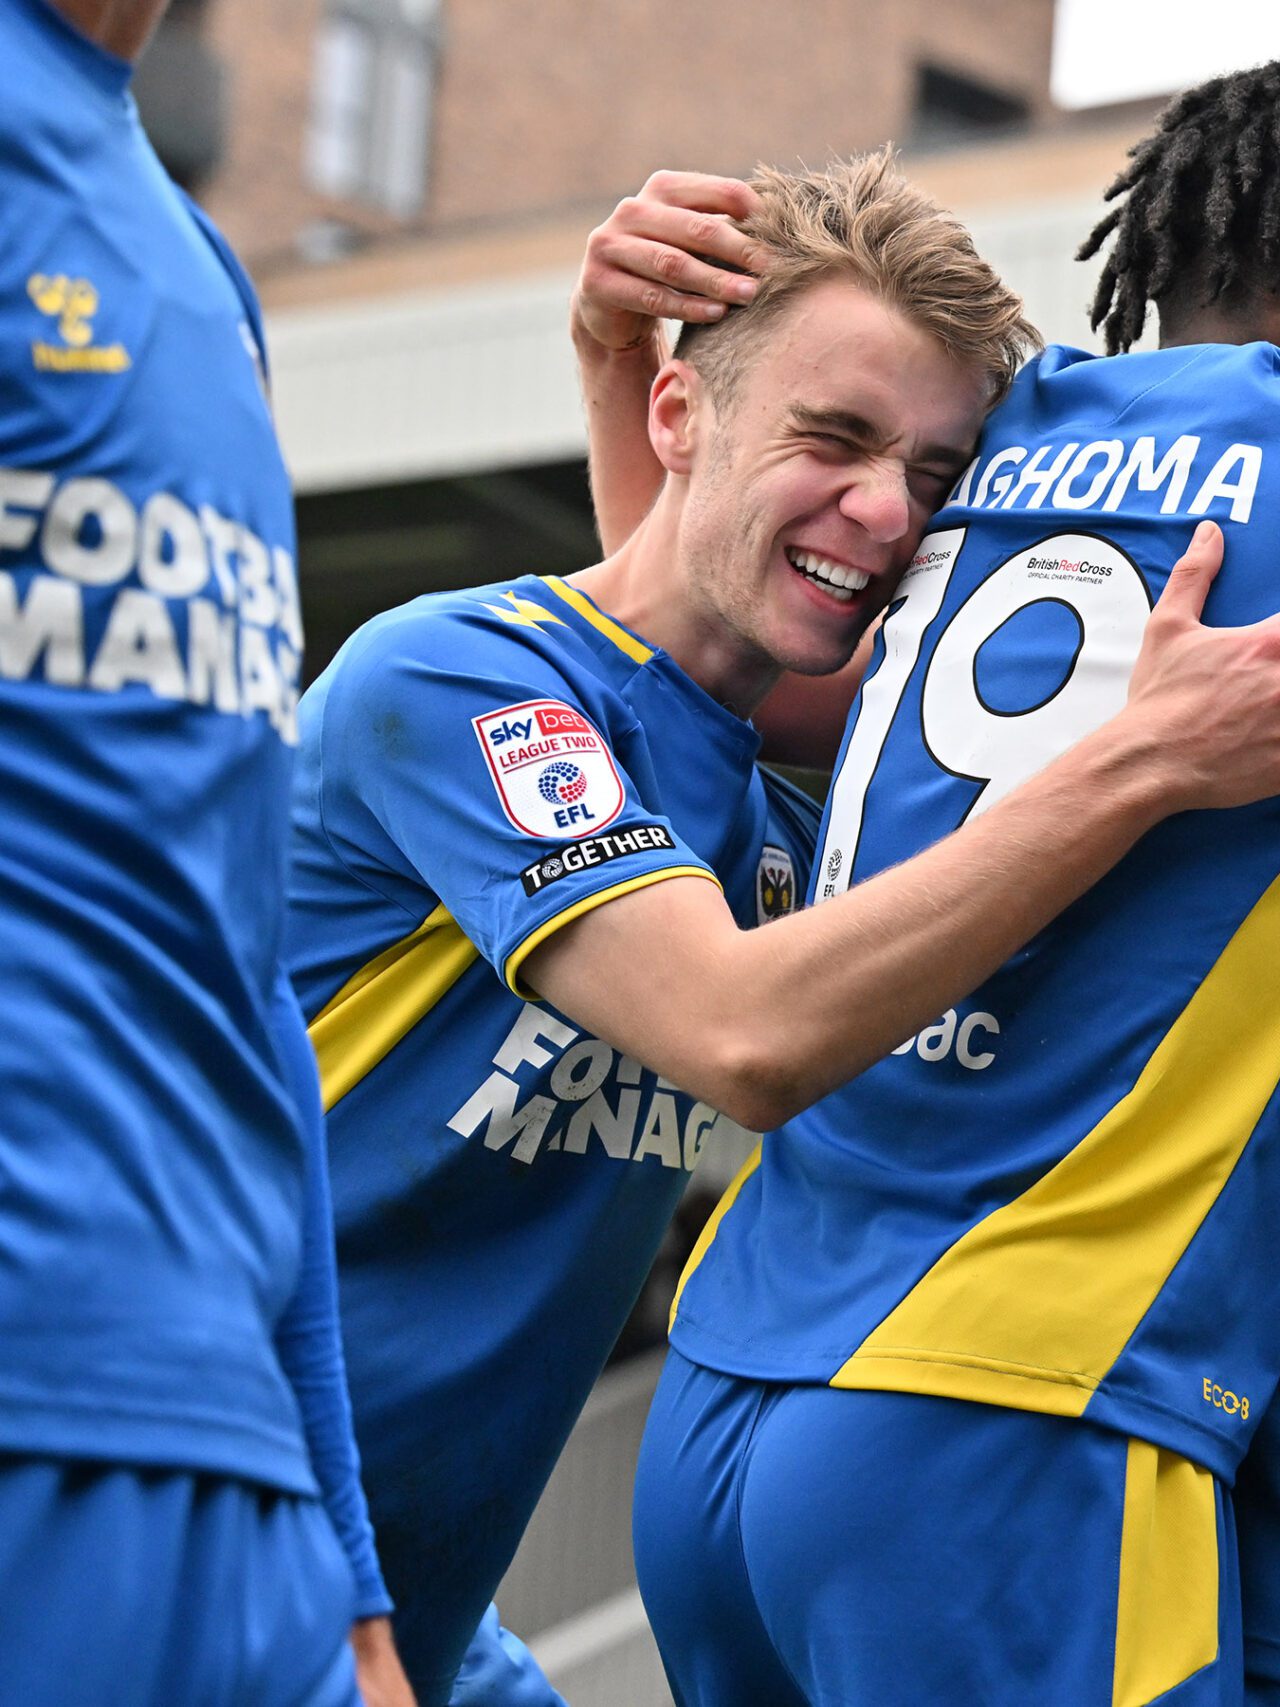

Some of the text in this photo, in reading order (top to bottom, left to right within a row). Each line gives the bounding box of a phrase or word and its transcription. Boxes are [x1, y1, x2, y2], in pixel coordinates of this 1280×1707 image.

[1051, 573, 1075, 582] CHARITY
[1075, 575, 1104, 585] PARTNER
[489, 711, 585, 746] sky bet
[499, 736, 597, 769] LEAGUE TWO
[553, 803, 596, 829] EFL
[891, 1008, 1000, 1070] ac
[446, 1071, 716, 1172] MNAG
